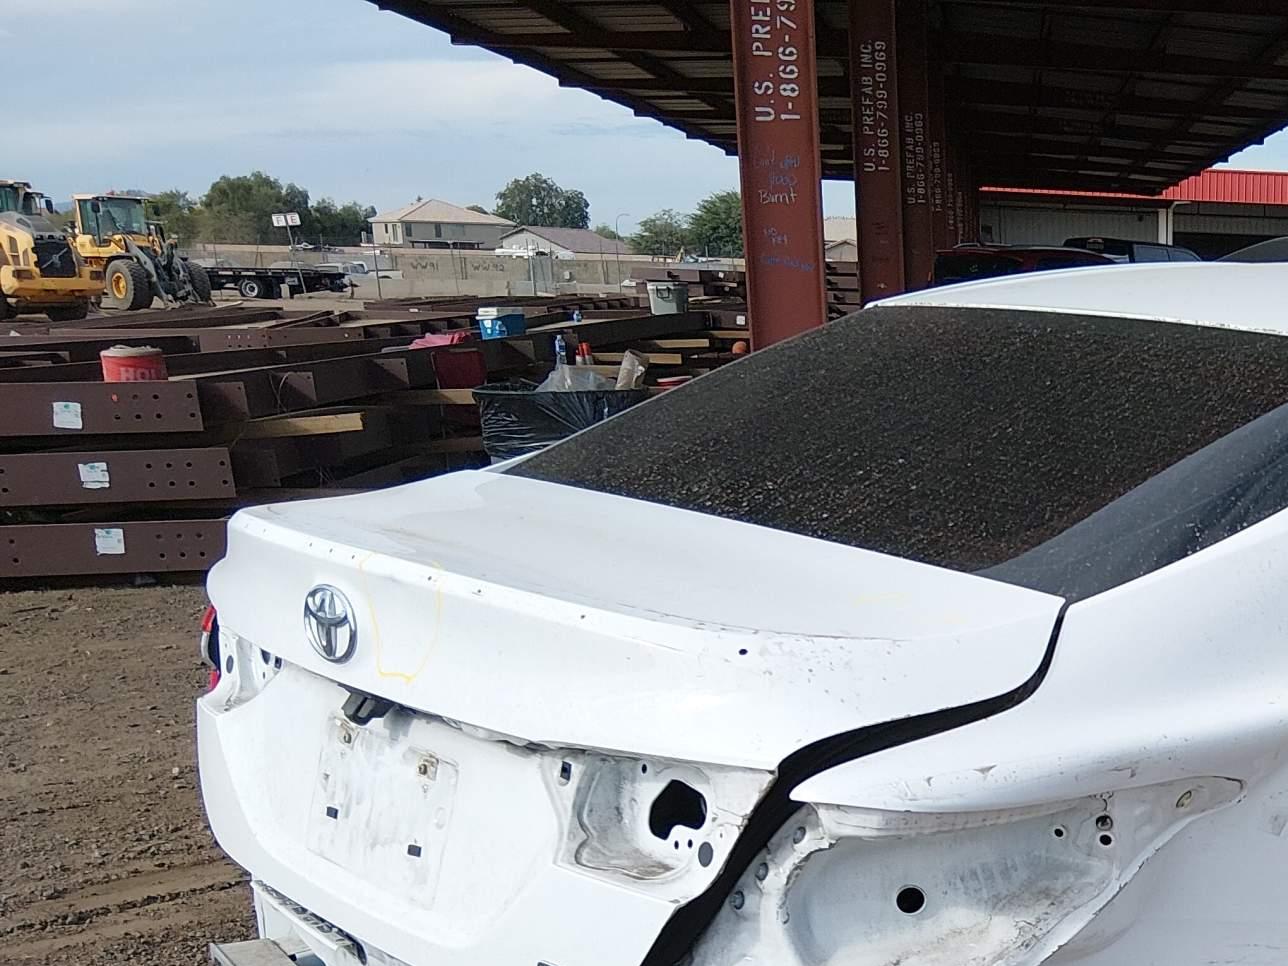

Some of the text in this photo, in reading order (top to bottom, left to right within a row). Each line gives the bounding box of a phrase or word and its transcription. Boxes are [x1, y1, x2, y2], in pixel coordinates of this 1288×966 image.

[751, 0, 776, 122] U.S. PRE
[859, 40, 876, 172] U.S. PREFAB INC.
[874, 41, 890, 171] 1-866-799-0969
